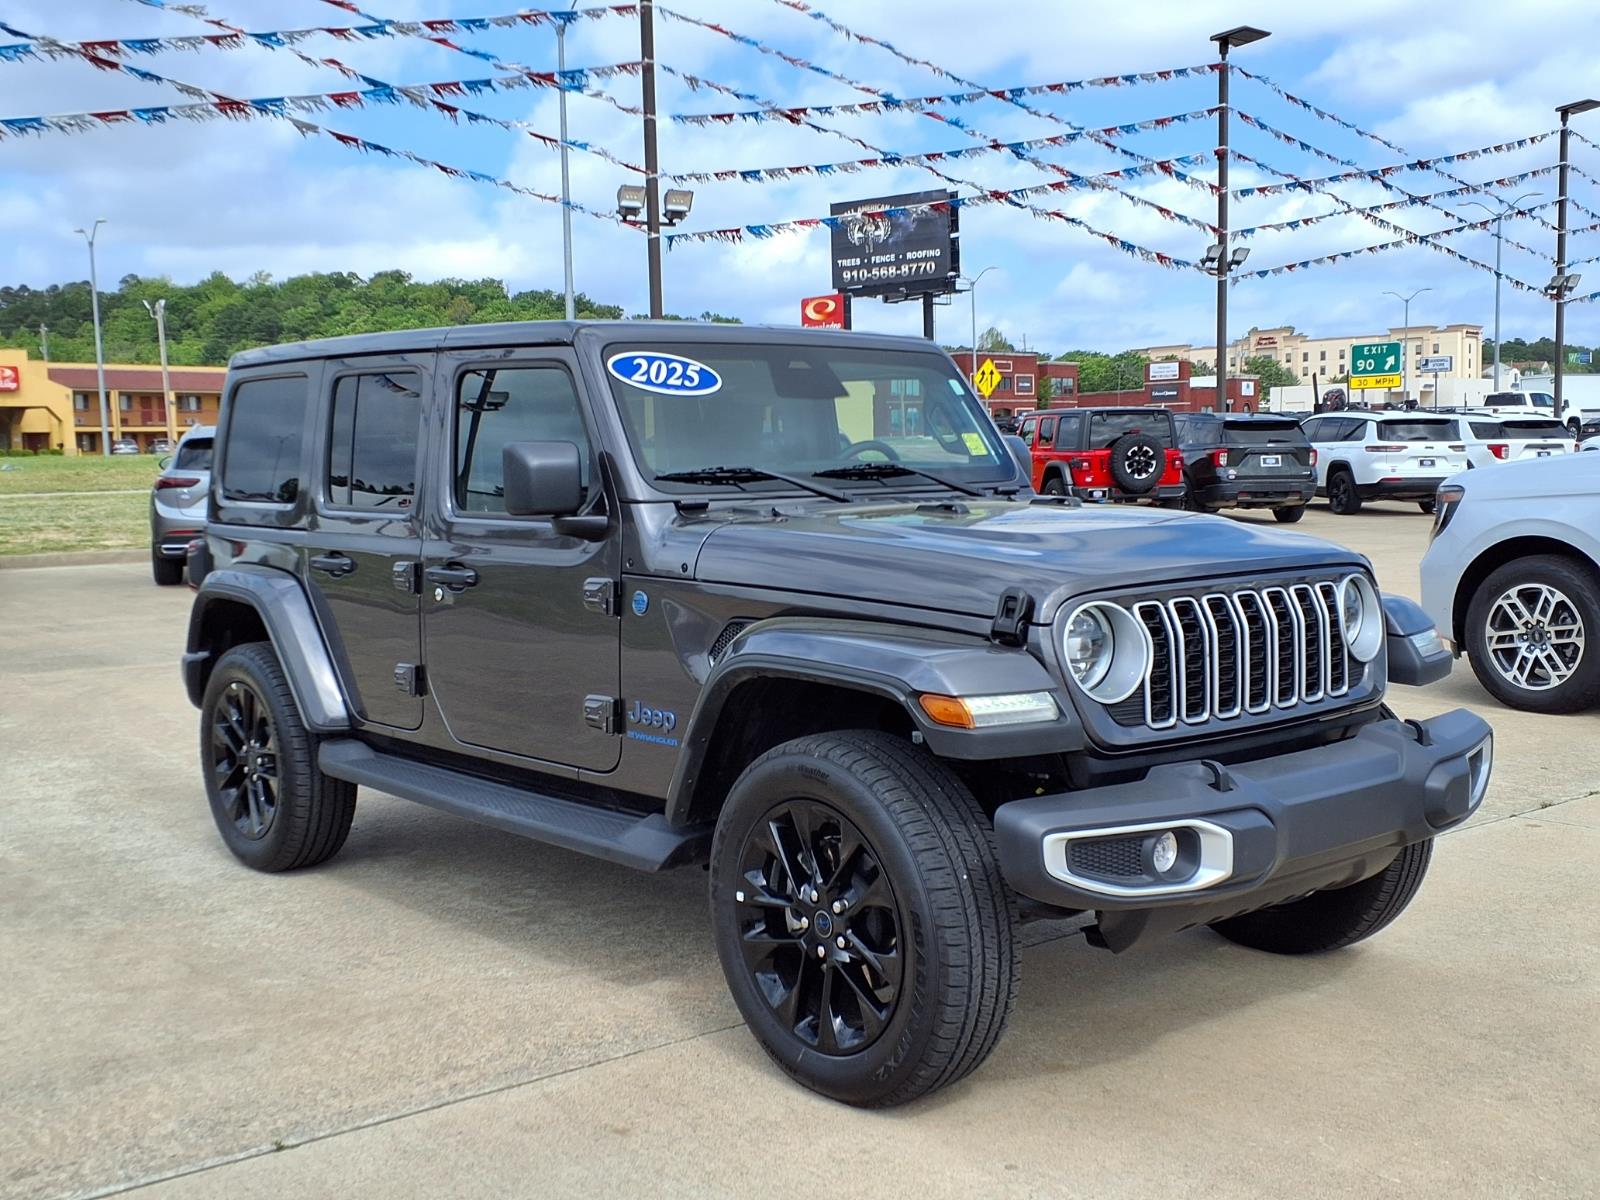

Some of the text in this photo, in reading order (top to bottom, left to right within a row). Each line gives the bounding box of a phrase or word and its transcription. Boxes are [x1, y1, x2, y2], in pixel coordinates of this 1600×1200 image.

[837, 249, 941, 267] TREES FENCE ROOFING
[842, 261, 936, 283] 910-568-8770
[1363, 345, 1388, 355] EXIT
[631, 358, 701, 387] 2025
[1356, 359, 1375, 371] 90
[1357, 377, 1394, 387] 30 MPH
[628, 700, 676, 734] Jeep
